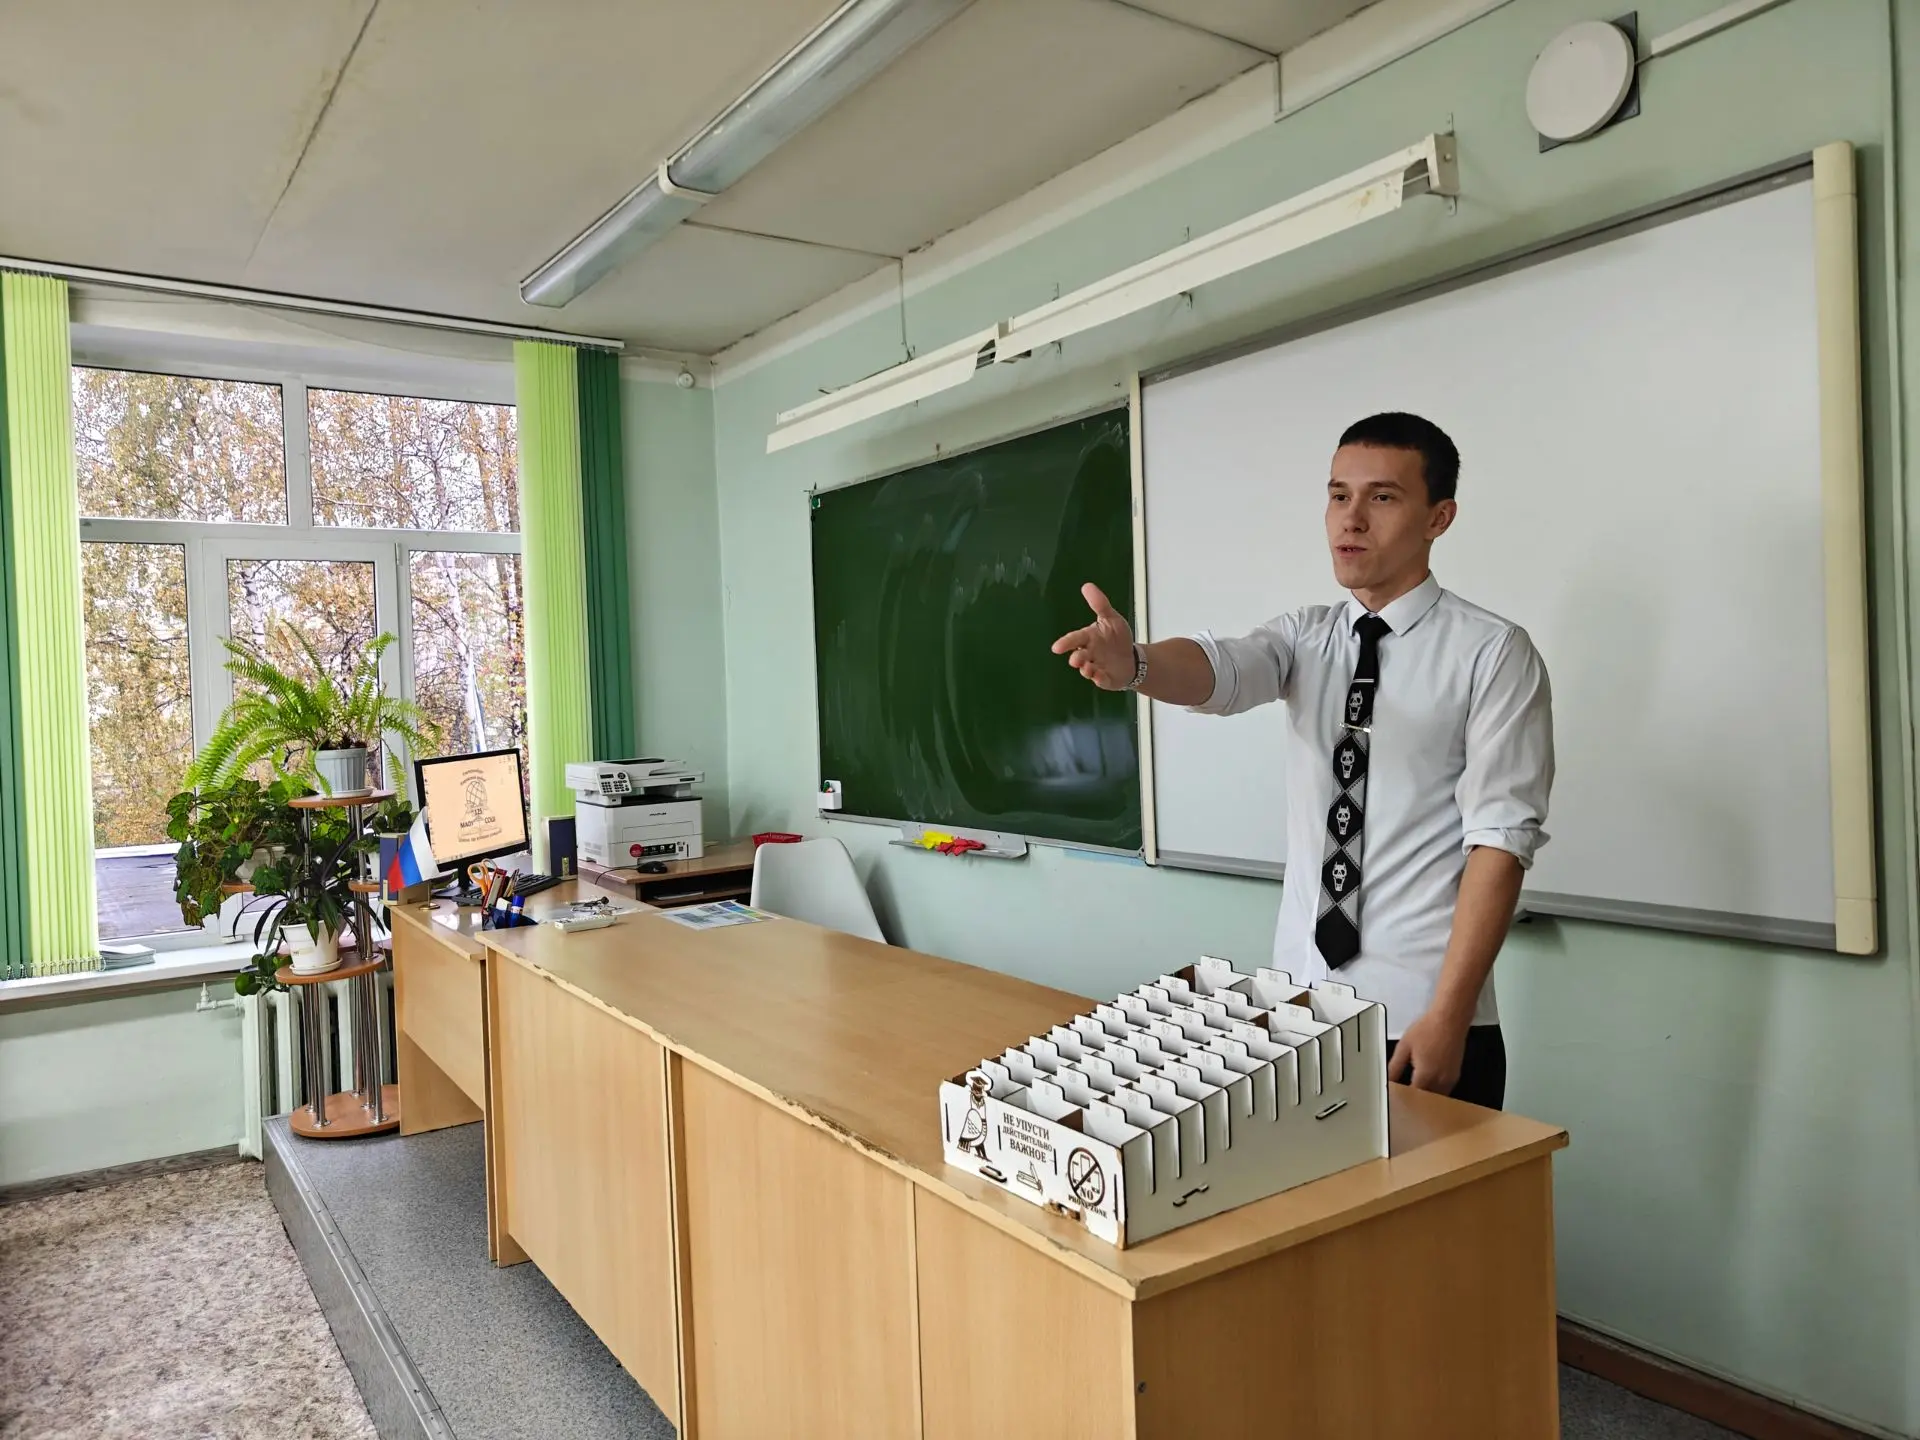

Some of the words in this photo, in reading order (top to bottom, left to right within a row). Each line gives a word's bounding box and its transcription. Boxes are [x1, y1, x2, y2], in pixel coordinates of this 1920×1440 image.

[1002, 1126, 1052, 1152] ДЕЙСТВИТЕЛЬНО
[1003, 1112, 1014, 1126] НЕ
[1016, 1117, 1050, 1141] УПУСТИ
[1010, 1138, 1047, 1163] ВАЖНОЕ
[1080, 1186, 1094, 1201] NO
[1090, 1205, 1108, 1219] ZONE
